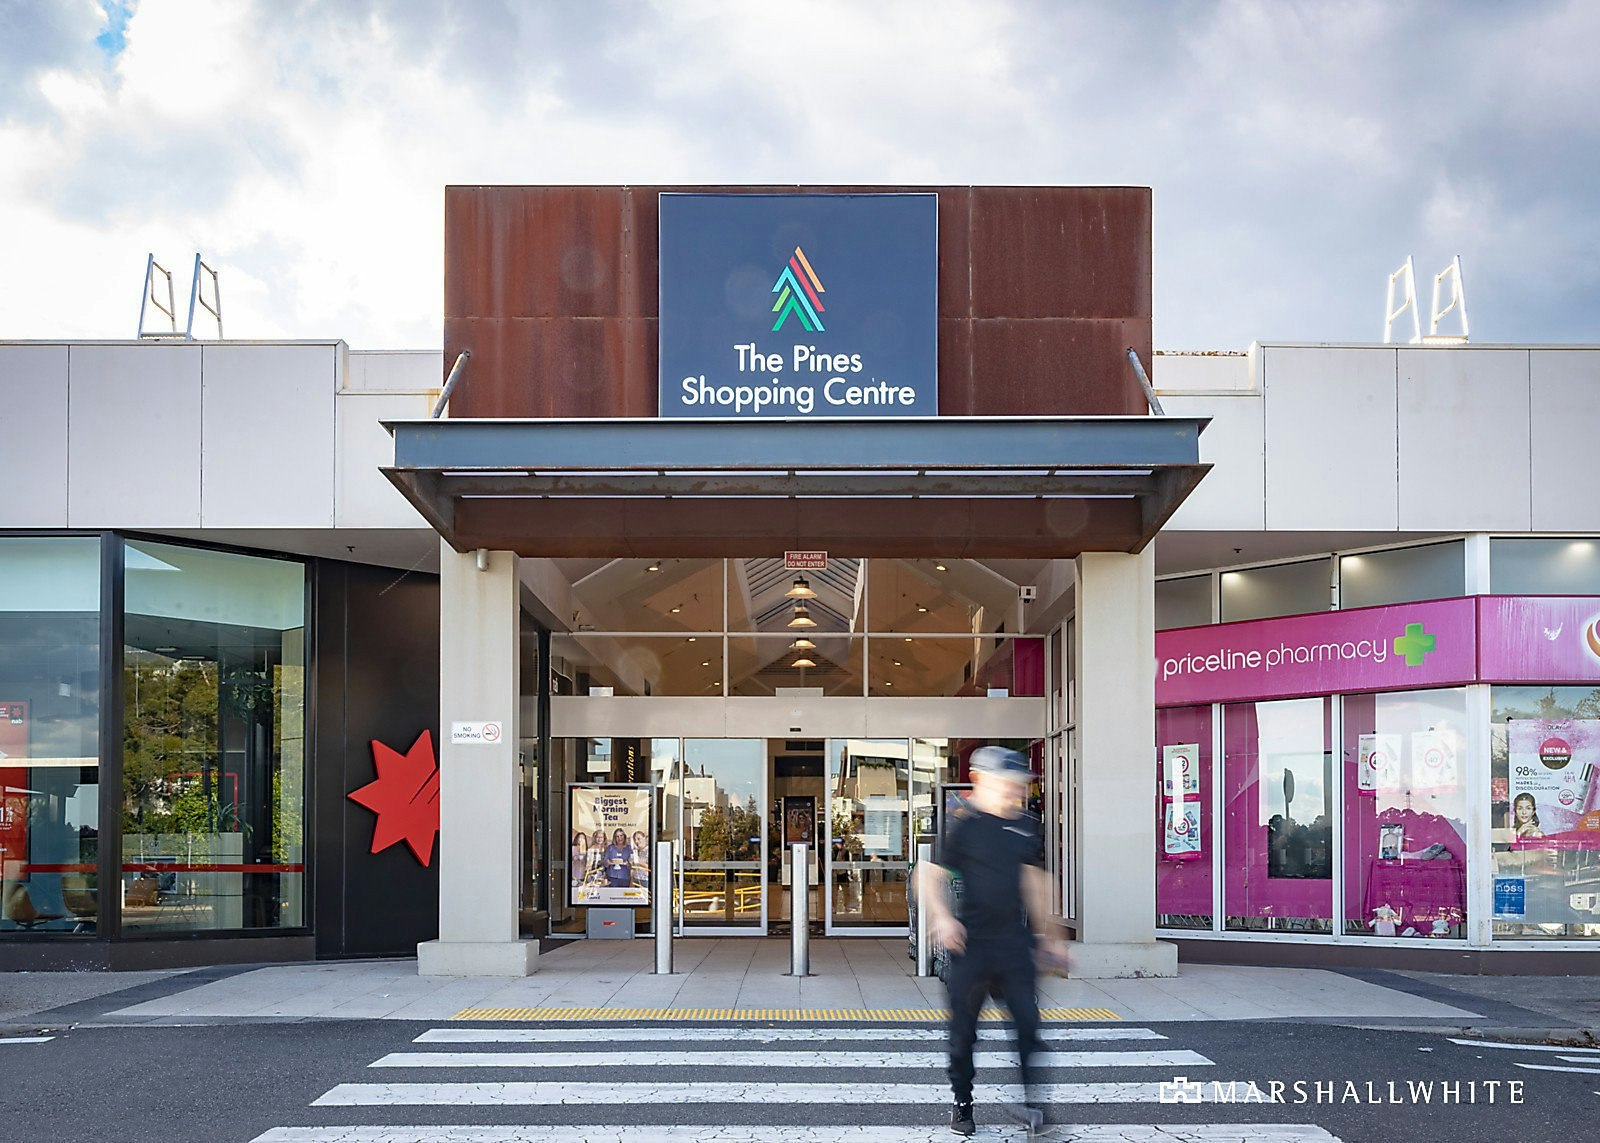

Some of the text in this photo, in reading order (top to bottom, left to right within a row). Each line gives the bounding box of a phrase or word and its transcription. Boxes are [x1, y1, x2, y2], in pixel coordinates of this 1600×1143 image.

[733, 343, 863, 372] The Pines
[681, 375, 916, 413] Shopping Centre
[1163, 638, 1387, 681] priceline pharmacy
[1515, 766, 1537, 776] 98%
[593, 805, 629, 814] Morning
[595, 797, 627, 806] Biggest
